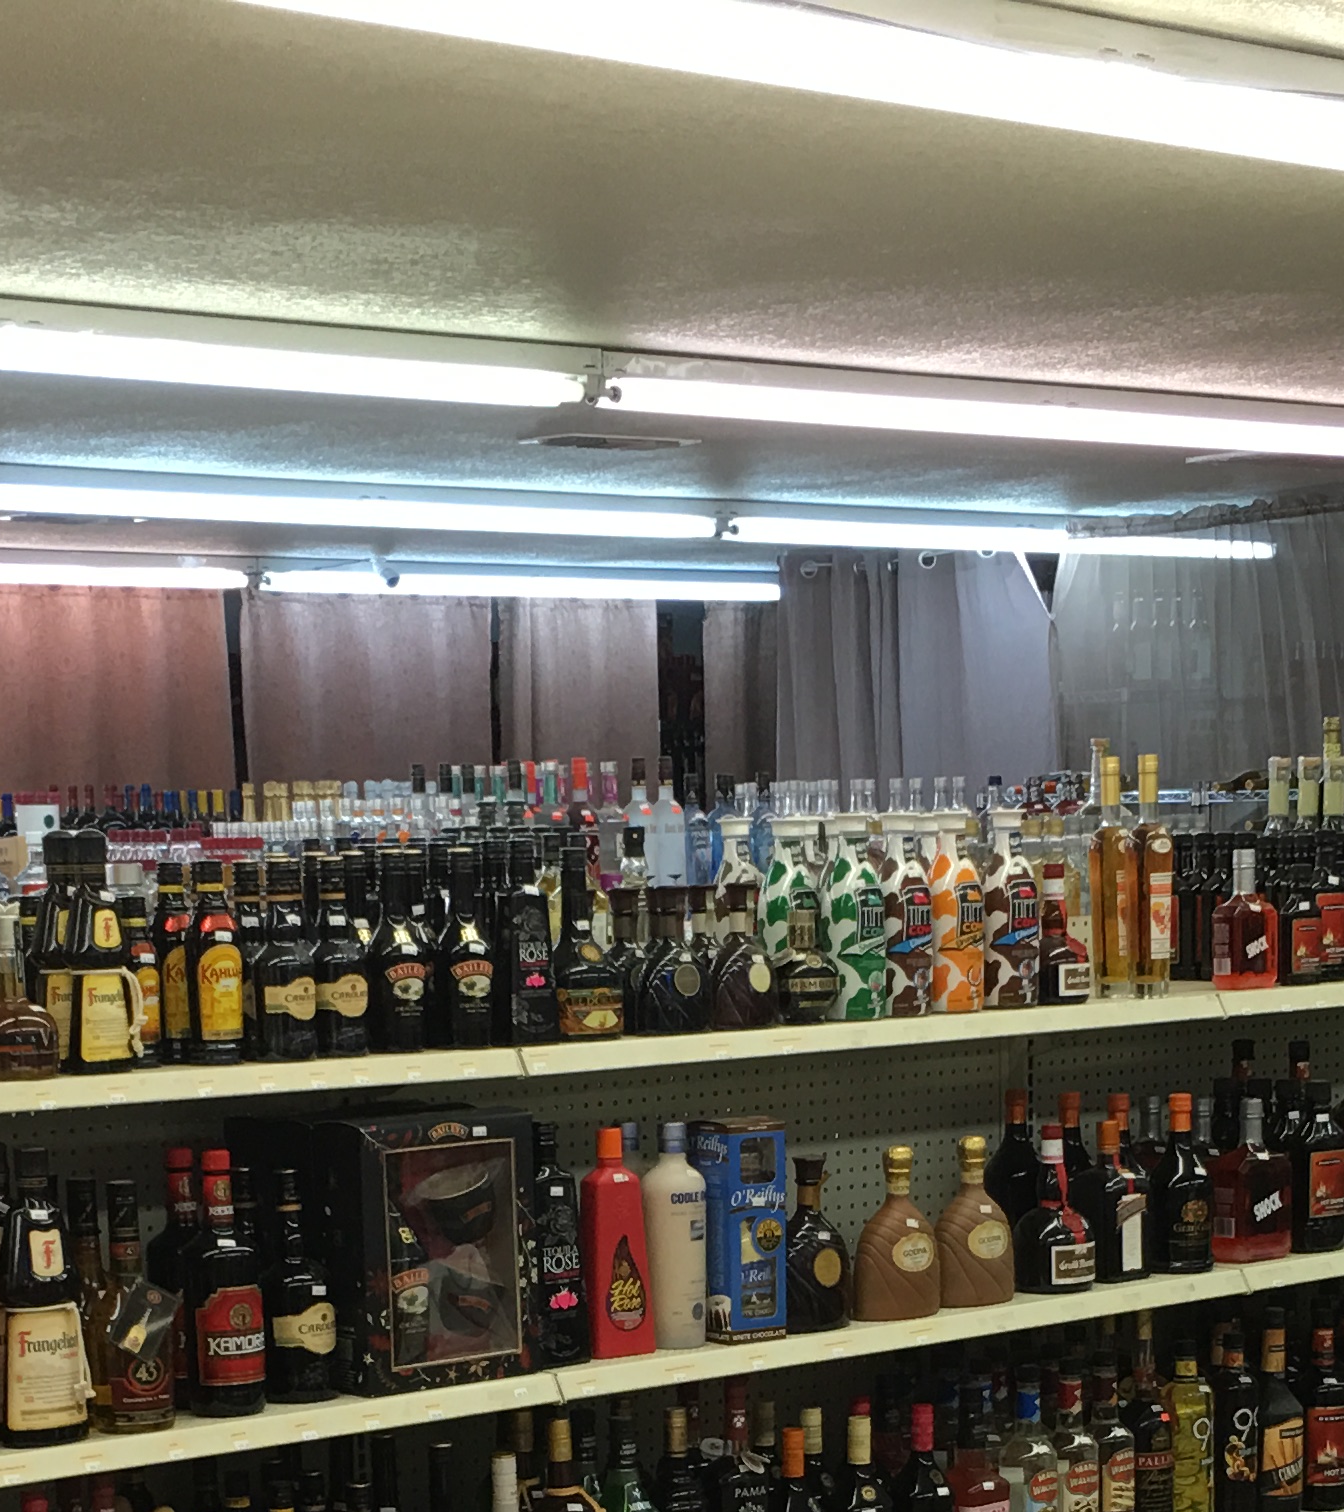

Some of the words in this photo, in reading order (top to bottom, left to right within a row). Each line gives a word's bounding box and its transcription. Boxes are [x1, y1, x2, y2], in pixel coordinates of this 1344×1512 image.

[519, 947, 549, 962] ROSE
[543, 1244, 580, 1258] TEQUILA
[543, 1254, 580, 1274] ROSE
[136, 1358, 158, 1382] 43
[734, 1485, 768, 1498] PAMA
